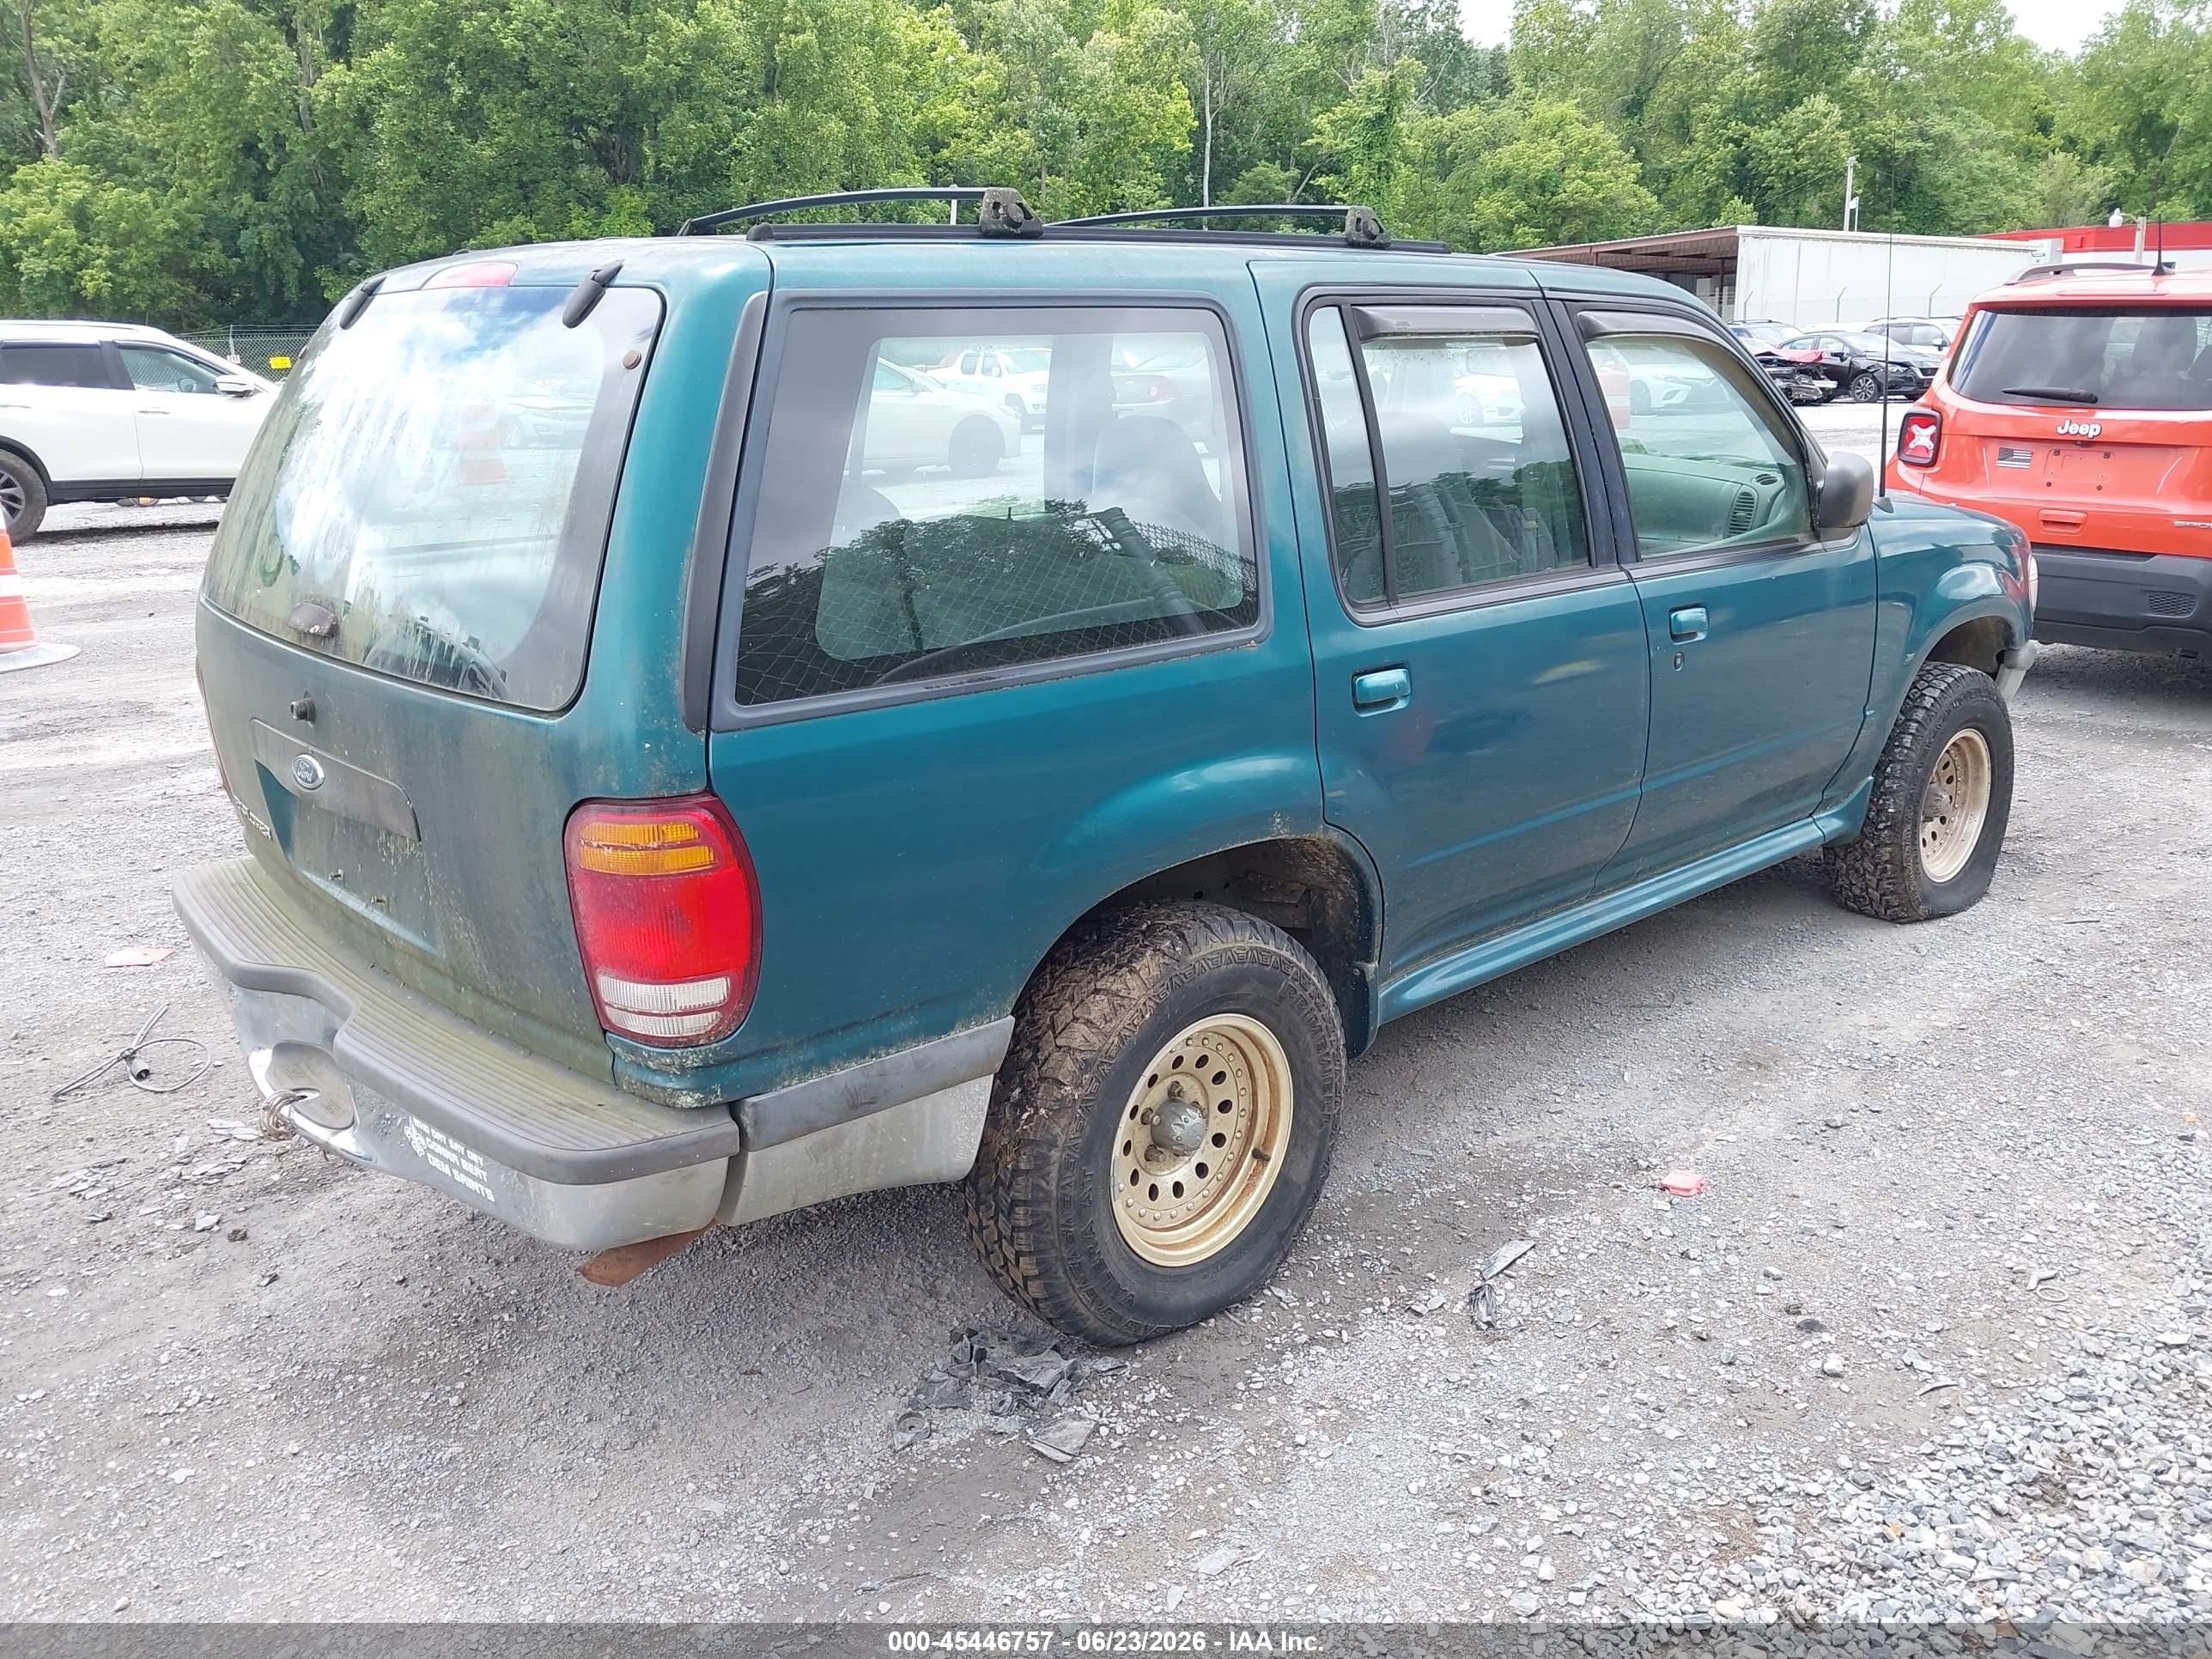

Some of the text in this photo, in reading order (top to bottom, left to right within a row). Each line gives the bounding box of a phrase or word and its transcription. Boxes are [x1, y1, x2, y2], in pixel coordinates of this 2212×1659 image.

[2057, 419, 2102, 439] Jeep
[2173, 520, 2212, 529] SPO
[296, 761, 314, 783] Ford
